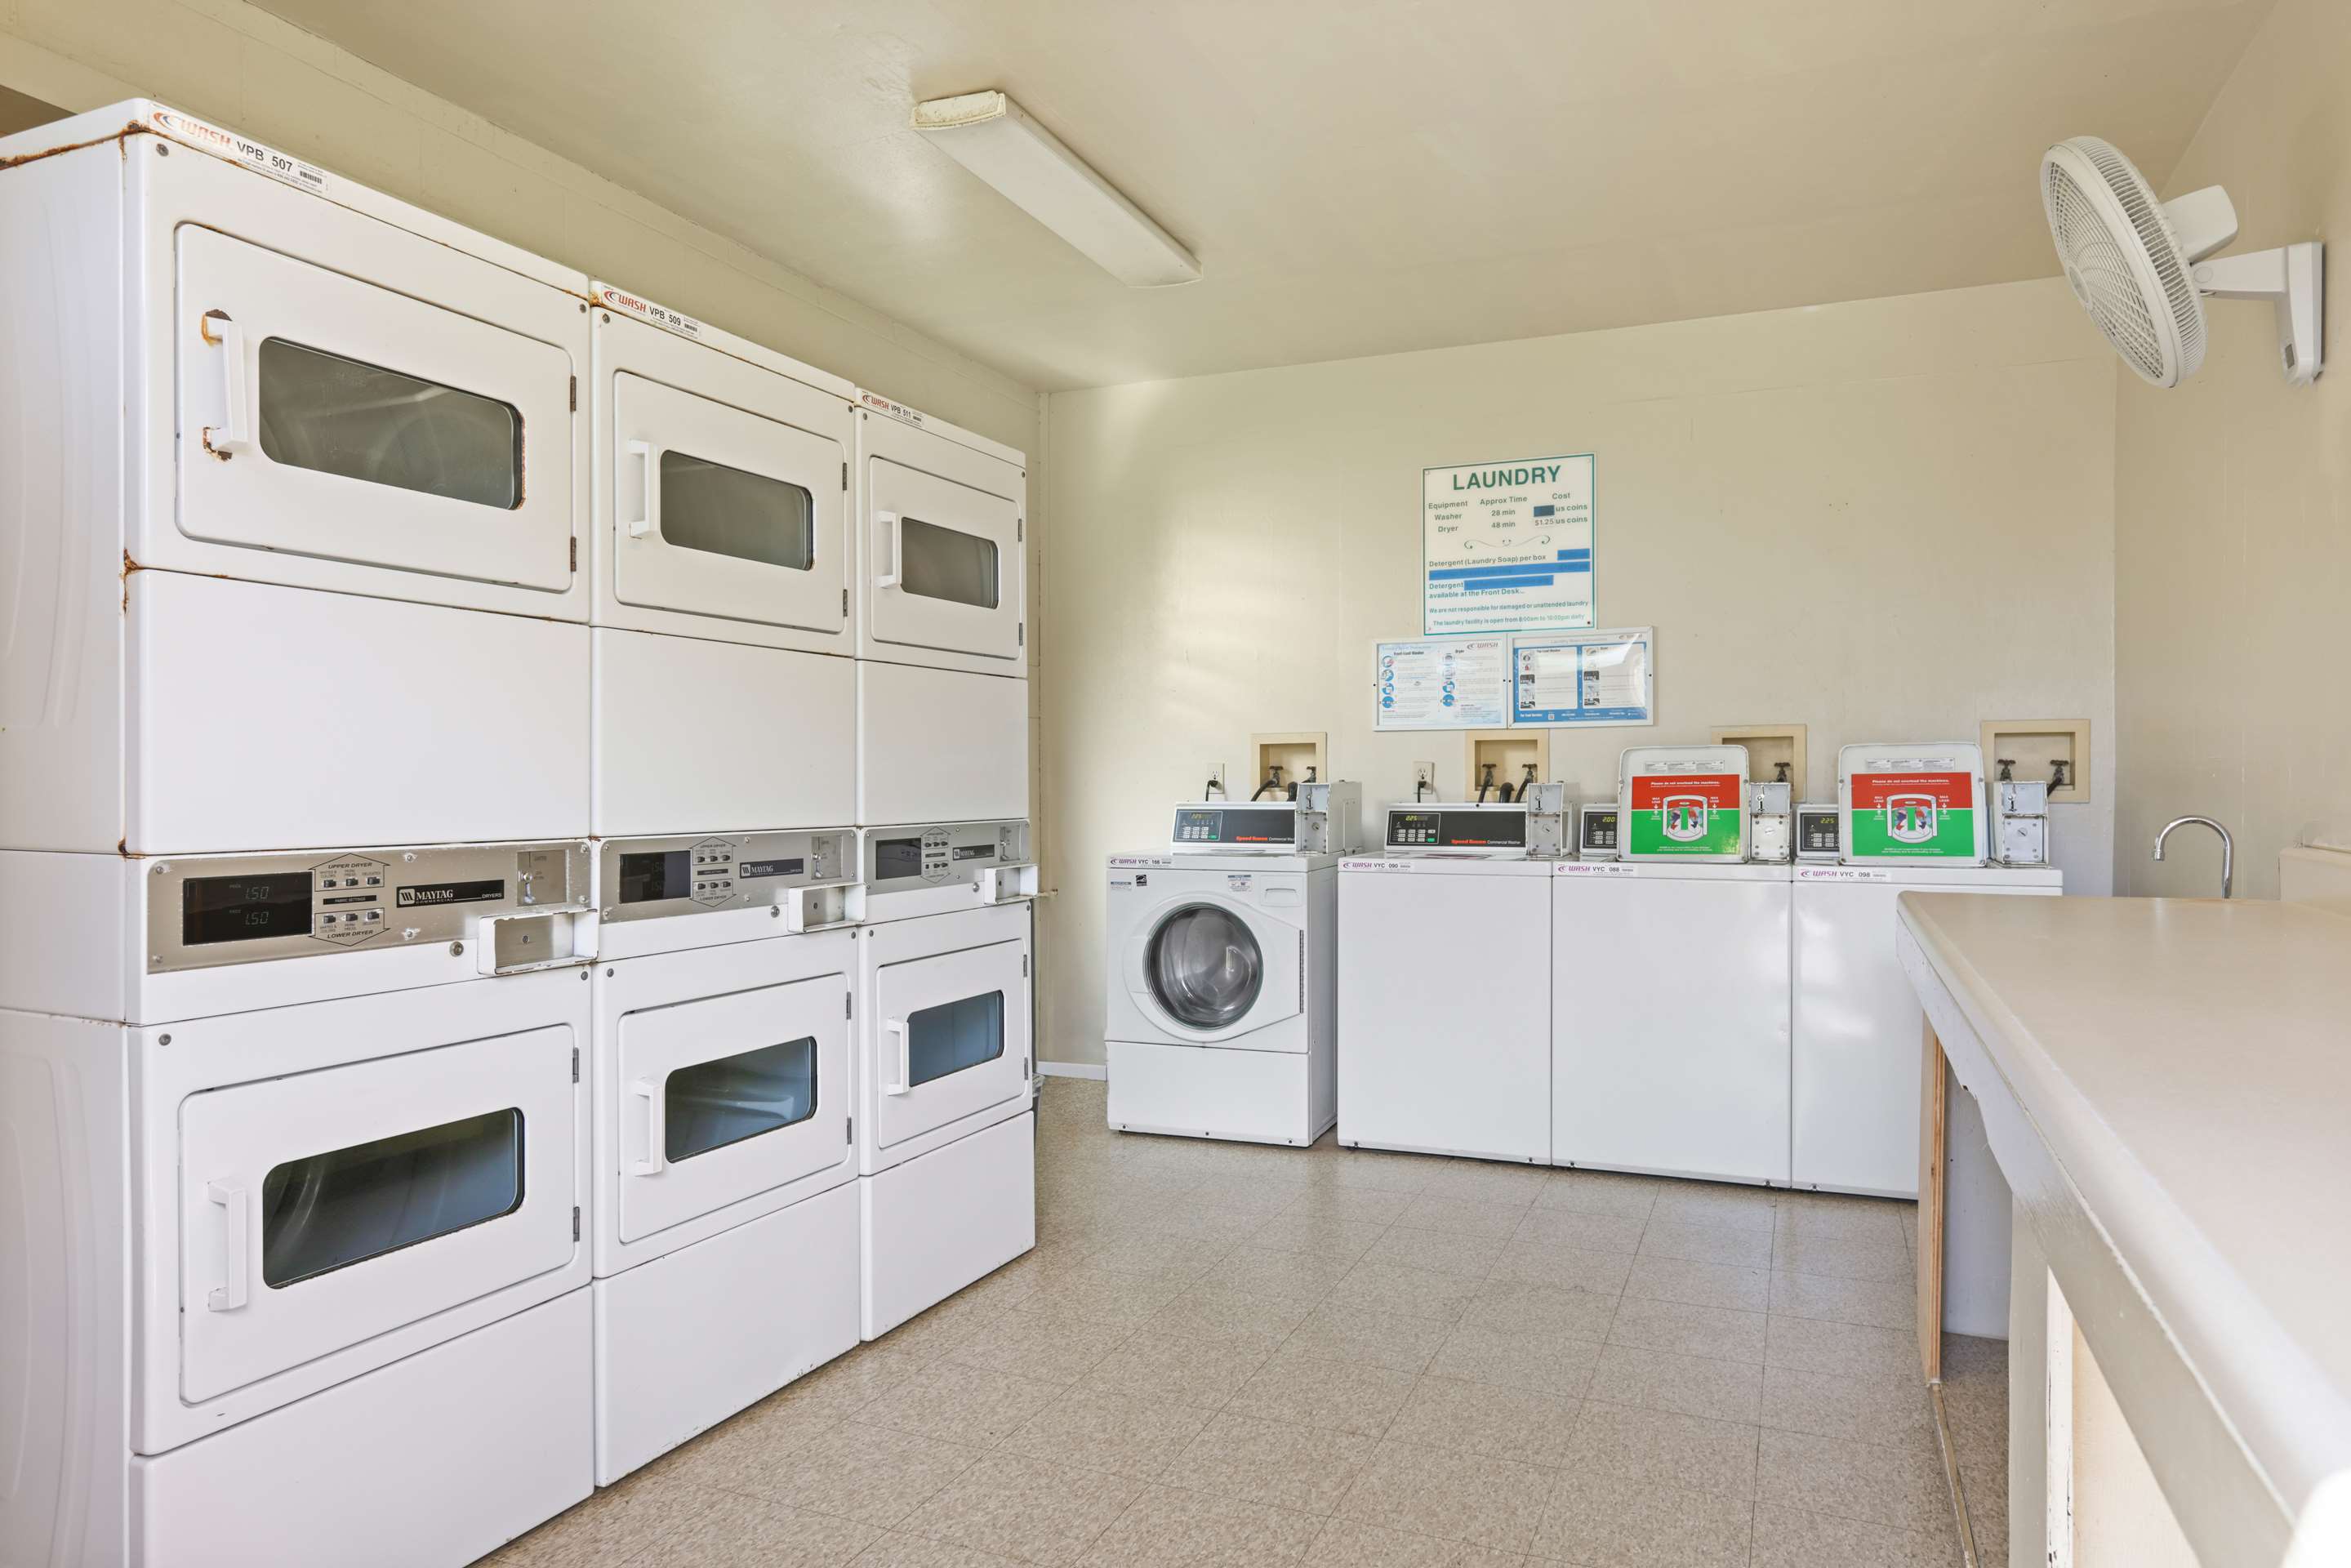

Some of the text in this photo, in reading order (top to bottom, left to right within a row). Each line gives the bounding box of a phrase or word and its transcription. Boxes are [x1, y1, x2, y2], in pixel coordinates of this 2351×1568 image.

[237, 140, 265, 161] VPB
[272, 156, 292, 172] 507
[618, 295, 681, 326] WASH VPB 509
[871, 396, 889, 410] WASH
[891, 404, 901, 414] VPB
[1453, 466, 1561, 490] LAUNDRY
[1428, 501, 1468, 510] Equipment
[1480, 498, 1507, 506] Approx
[1534, 519, 1554, 527] $1.25
[1429, 559, 1463, 568] Detergent
[1465, 557, 1496, 566] (Laundry
[1498, 555, 1519, 564] Soap)
[1429, 581, 1463, 590] Detergent
[1481, 588, 1500, 596] Front
[1458, 604, 1489, 612] responsible
[1499, 603, 1527, 611] damaged
[1534, 601, 1566, 609] unattended
[1567, 600, 1588, 608] laundry
[1465, 617, 1483, 626] facility
[416, 889, 454, 901] MAYTAG
